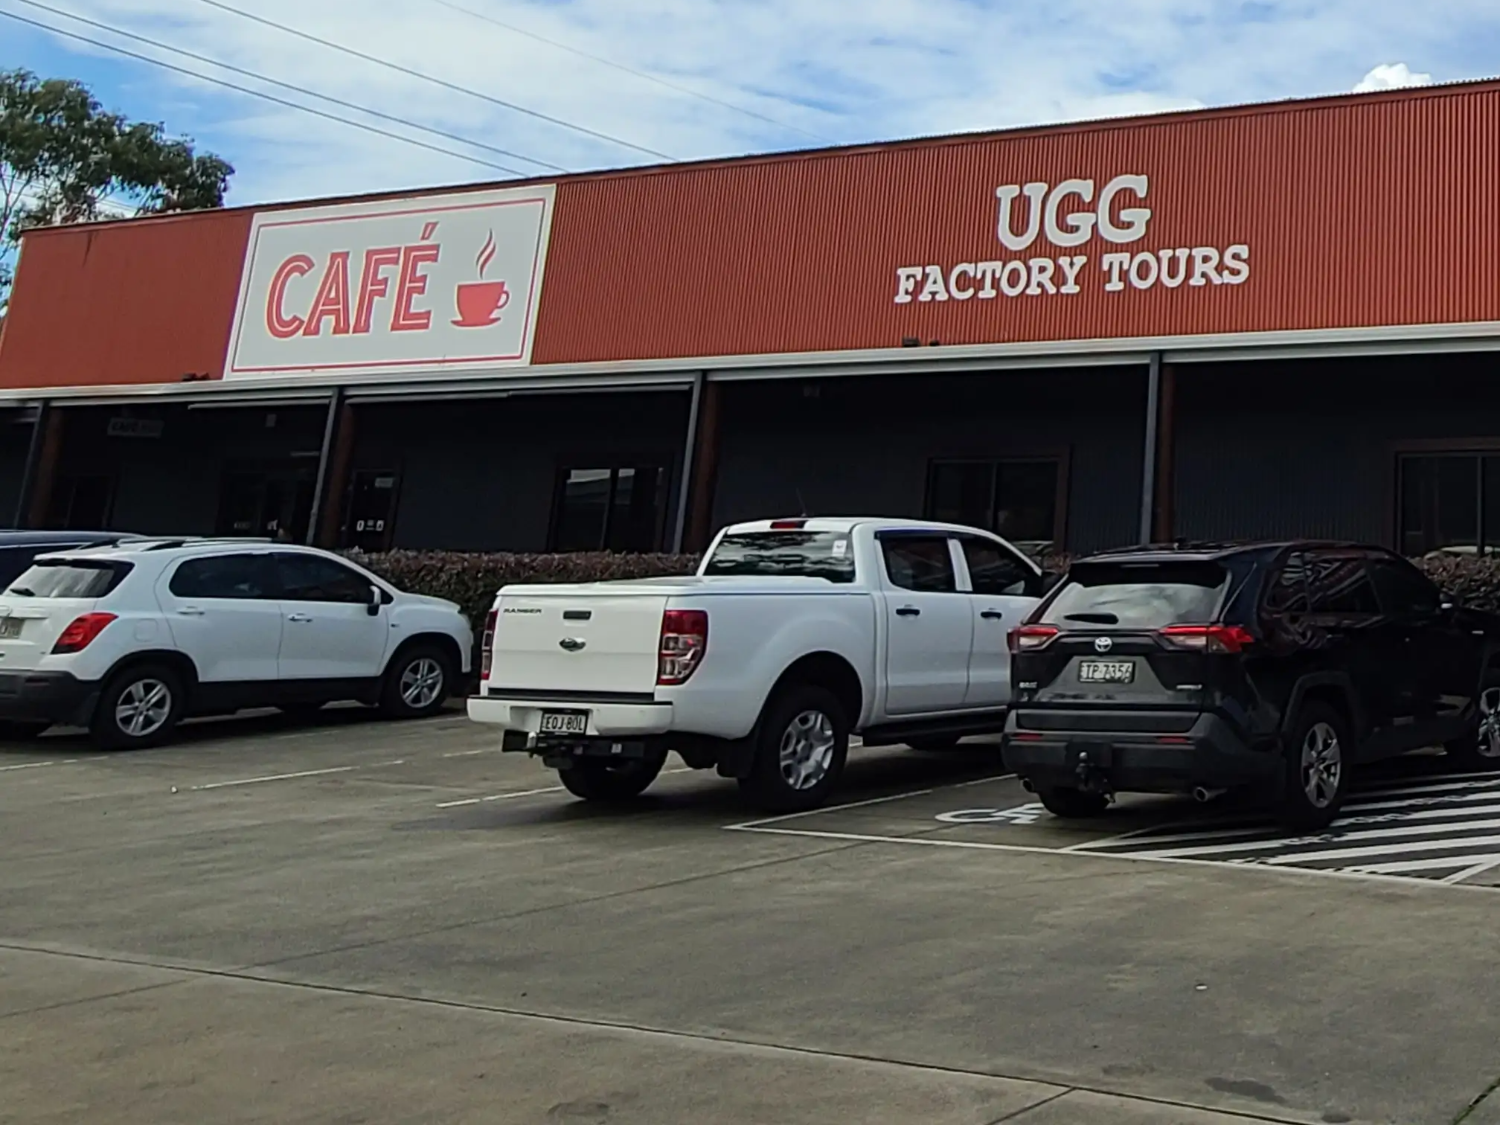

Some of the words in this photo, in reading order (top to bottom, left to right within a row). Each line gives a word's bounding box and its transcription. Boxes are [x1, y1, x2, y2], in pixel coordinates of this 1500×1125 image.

[995, 173, 1152, 251] UGG
[265, 220, 440, 339] CAFÉ
[893, 255, 1088, 304] FACTORY
[1101, 244, 1250, 292] TOURS
